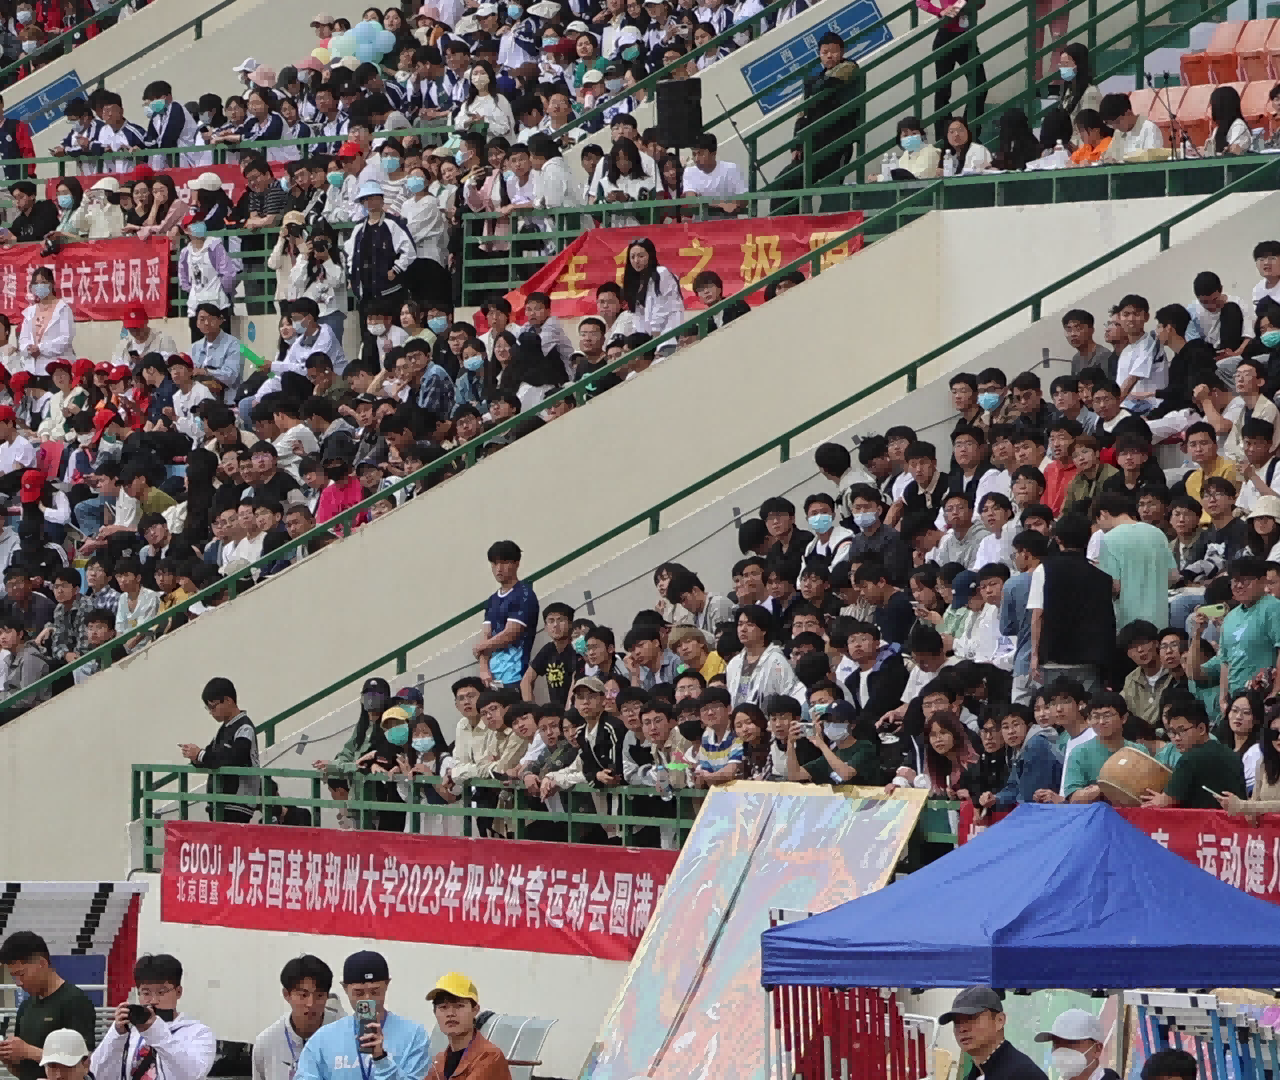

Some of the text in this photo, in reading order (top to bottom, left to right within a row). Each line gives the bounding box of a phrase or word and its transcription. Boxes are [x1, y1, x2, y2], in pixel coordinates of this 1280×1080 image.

[25, 256, 161, 305] 白衣天使风采
[549, 230, 850, 300] 生之极限
[176, 876, 219, 906] 北京国基
[226, 845, 670, 938] 北京国基祝郑州大学2023年阳光体育运动会圆满
